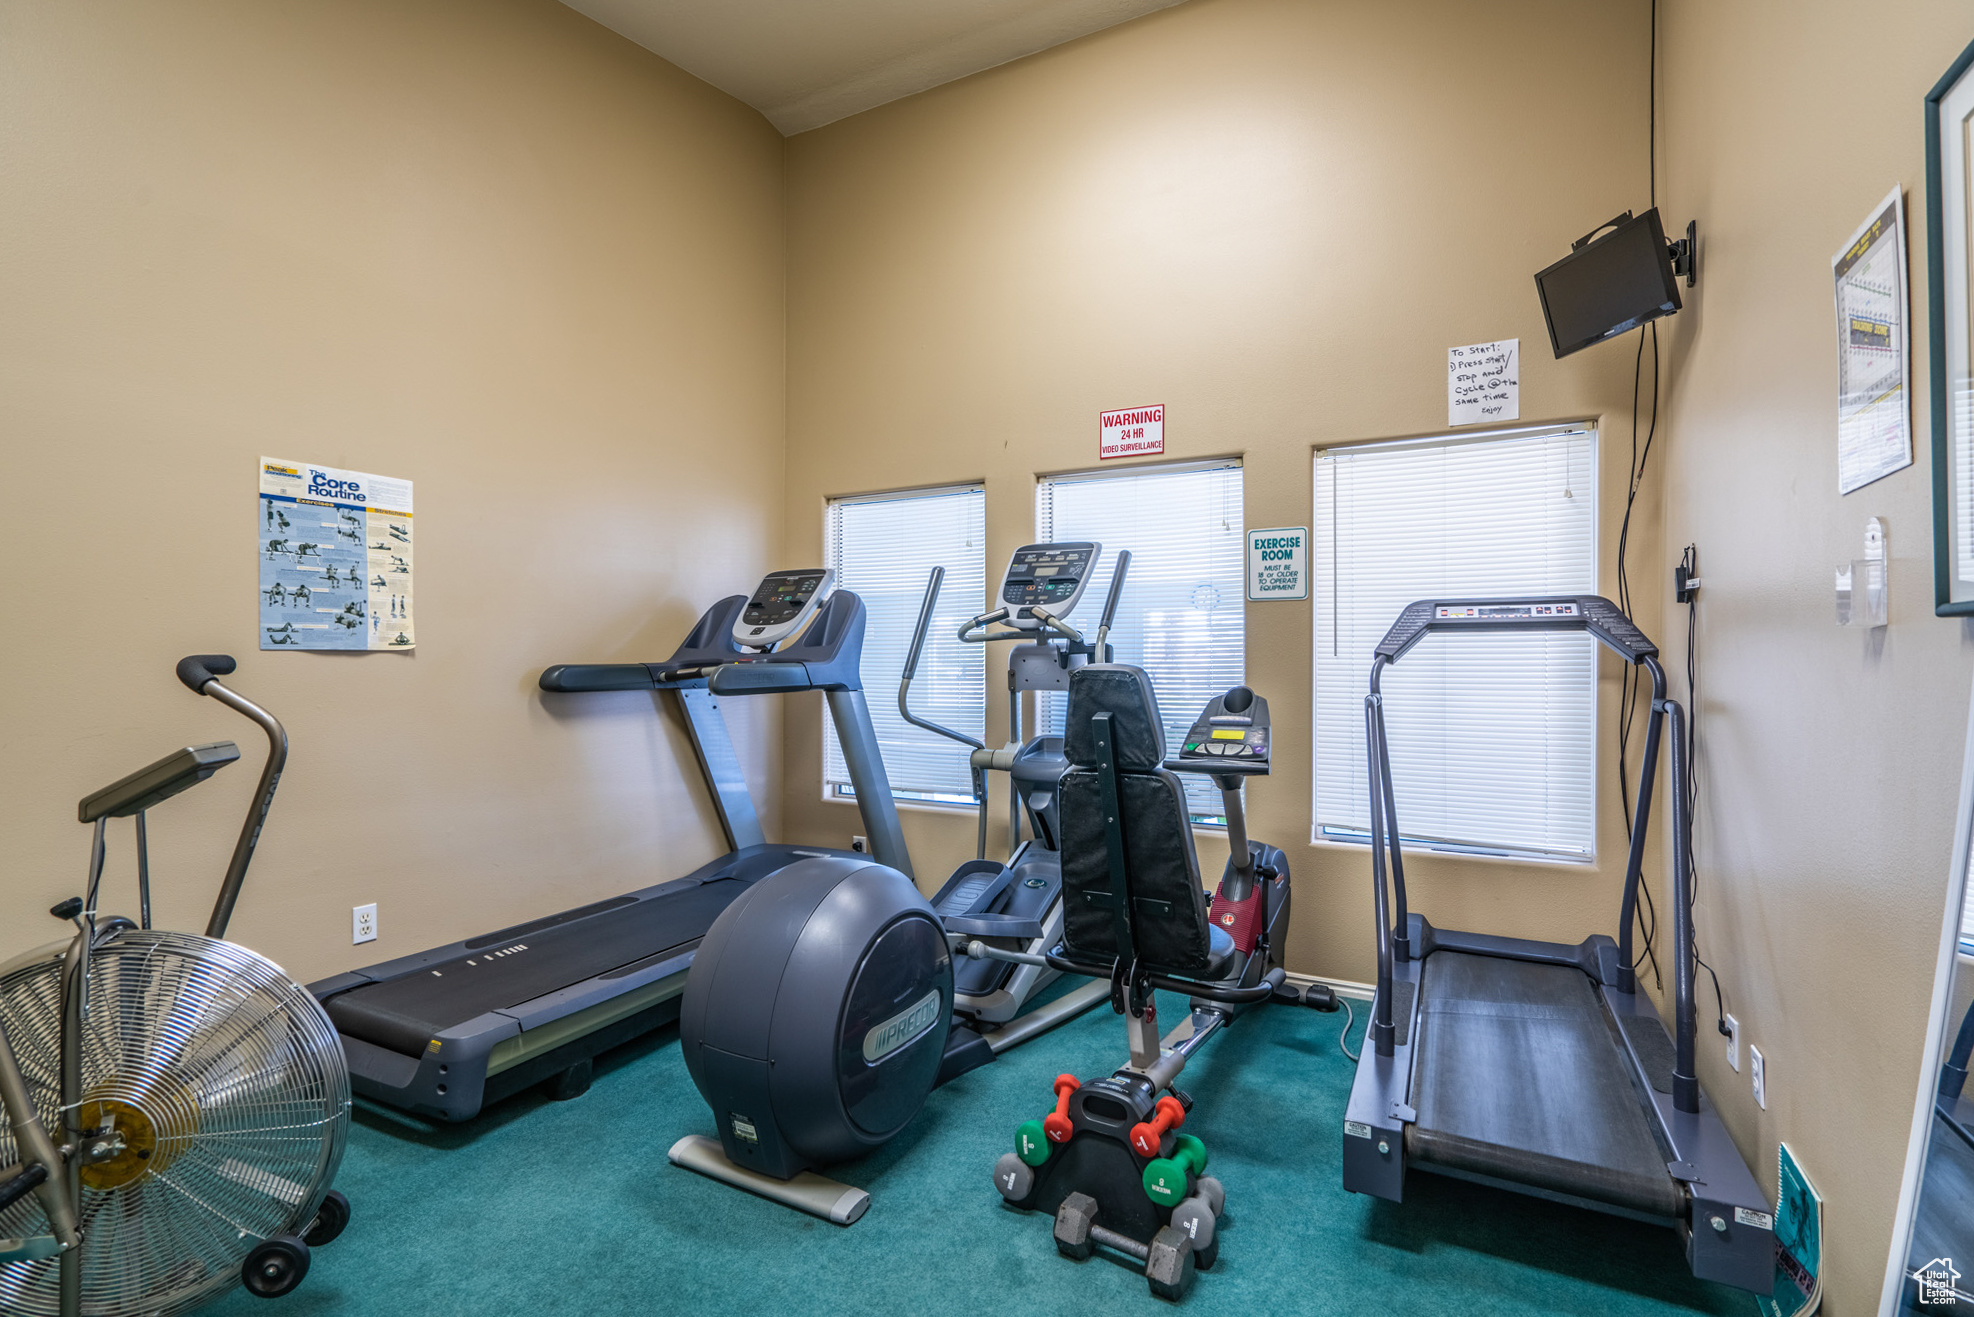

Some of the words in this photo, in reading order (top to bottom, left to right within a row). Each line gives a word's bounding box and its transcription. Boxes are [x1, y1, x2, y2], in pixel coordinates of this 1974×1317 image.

[1103, 410, 1161, 428] WARNING
[1121, 429, 1131, 440] 24
[1133, 428, 1144, 438] HR
[1102, 445, 1119, 453] VIDEO
[1120, 440, 1162, 452] SURVEILLANCE
[312, 475, 360, 492] Core
[308, 485, 366, 502] Routine
[296, 498, 335, 507] Exercises
[375, 508, 406, 517] Stretches
[1255, 537, 1300, 550] EXERCISE
[1262, 550, 1293, 561] ROOM
[886, 997, 936, 1044] PRECOR
[1159, 1178, 1164, 1186] 8
